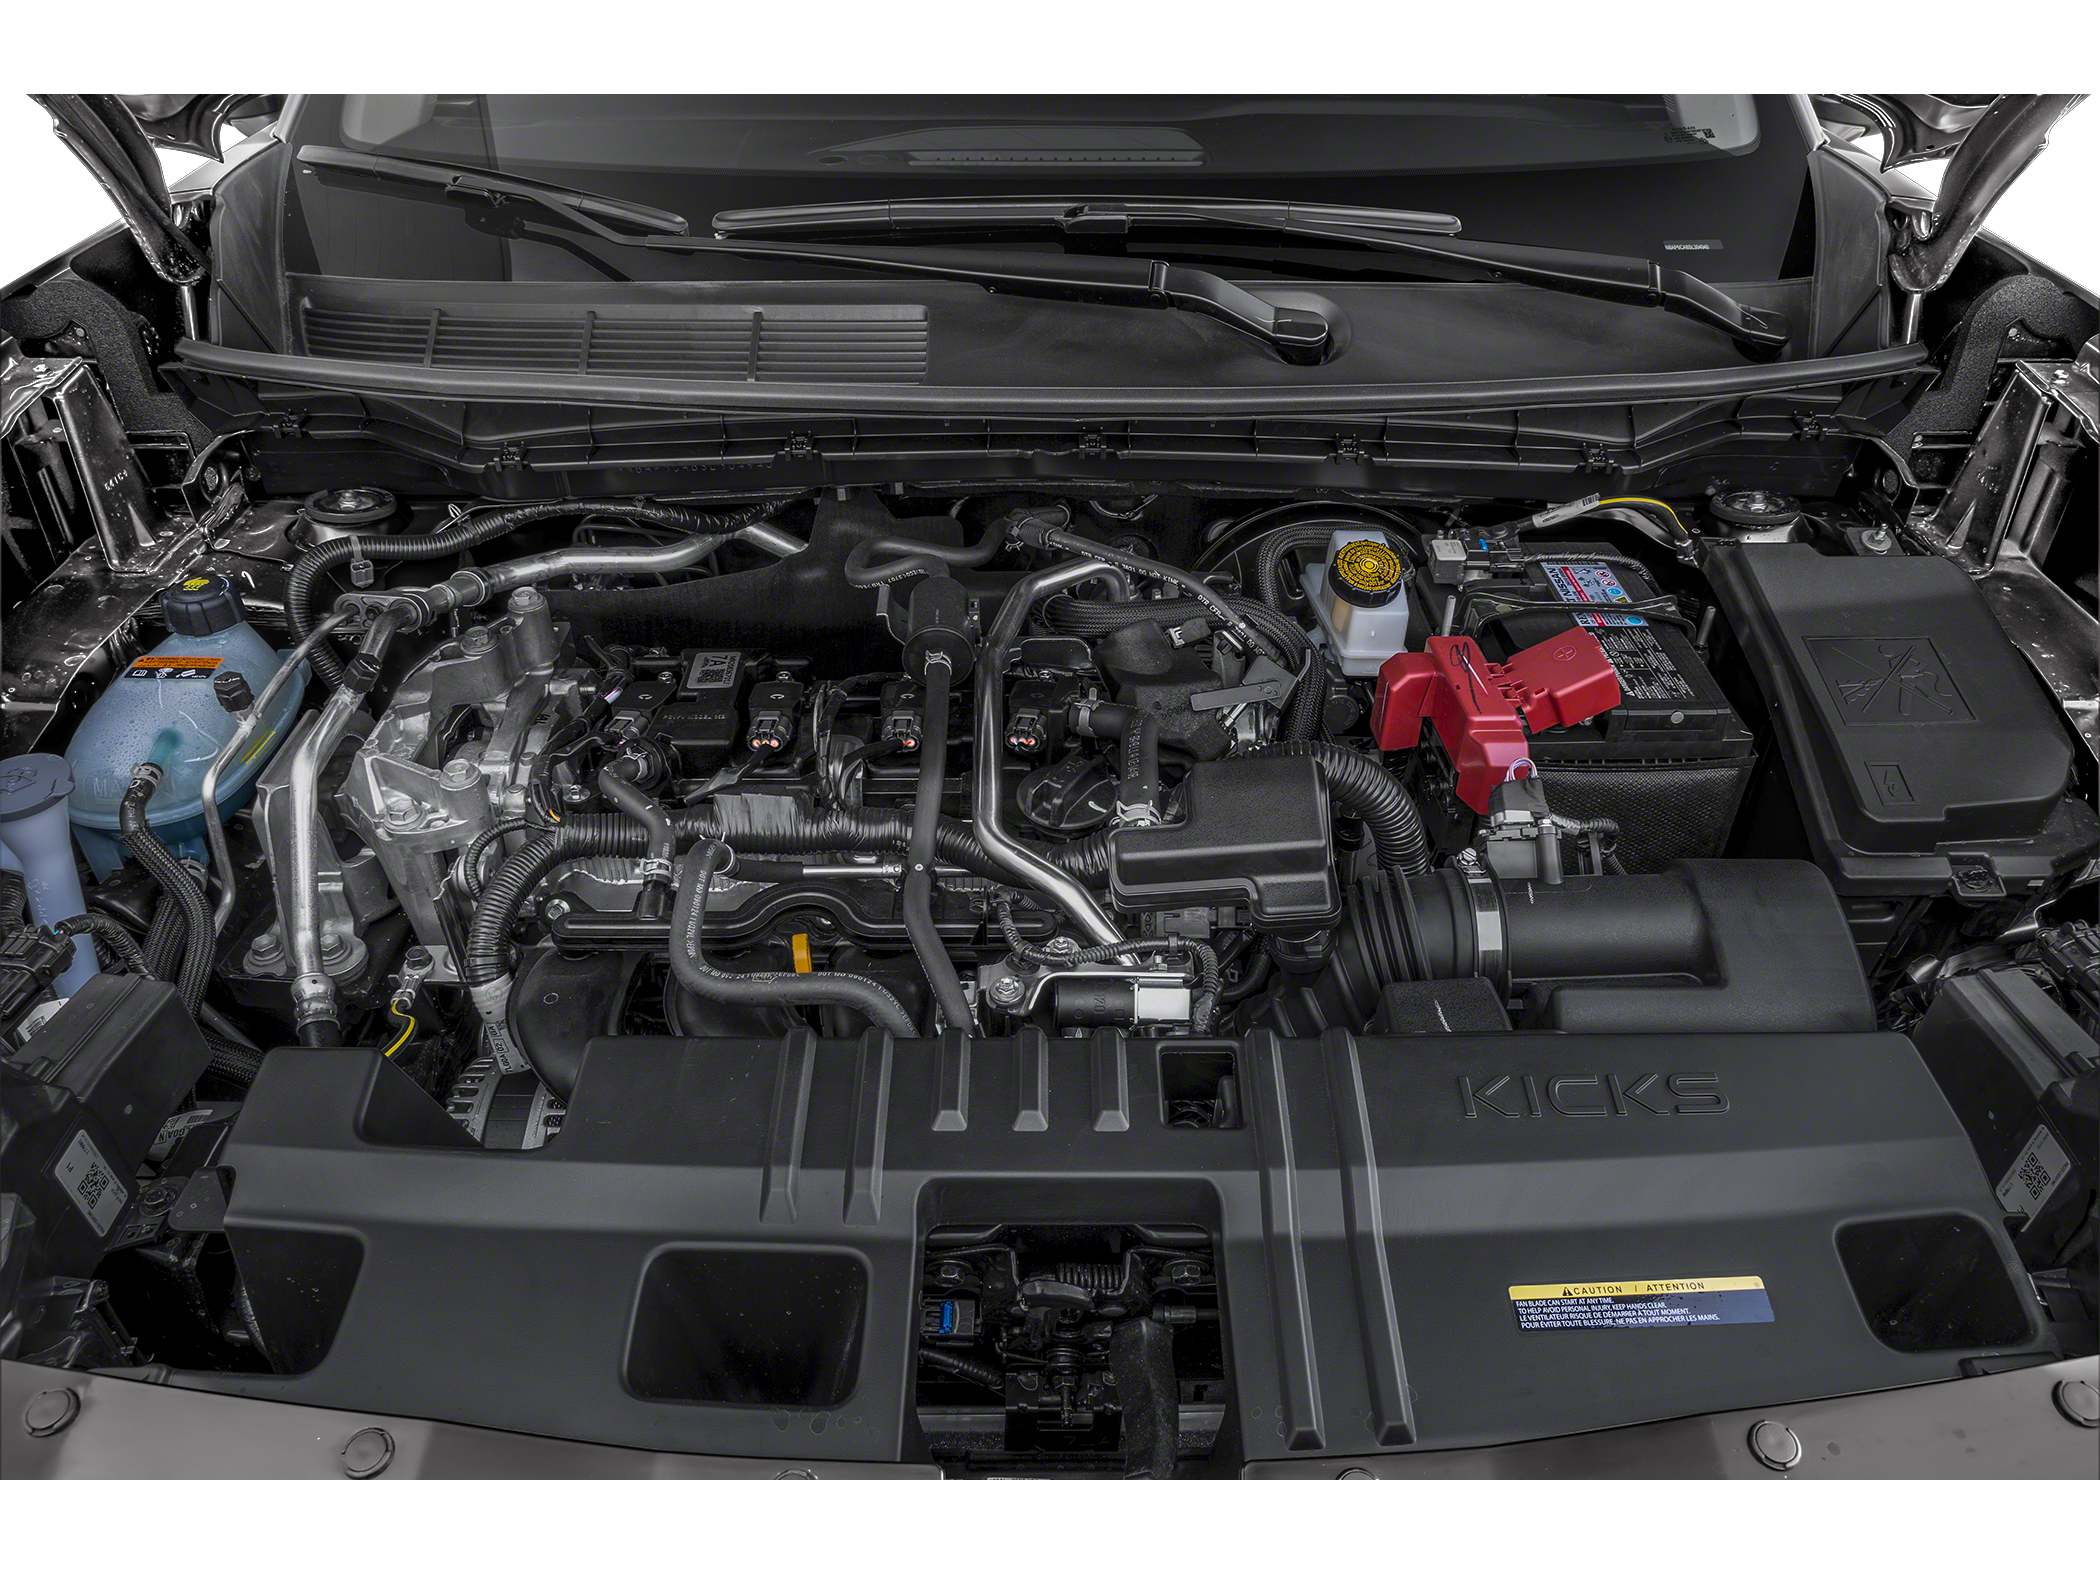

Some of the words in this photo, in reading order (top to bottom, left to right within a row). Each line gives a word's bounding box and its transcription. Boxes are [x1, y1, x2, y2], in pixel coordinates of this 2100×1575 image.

[1547, 567, 1573, 597] NISSAN
[1197, 594, 1209, 606] DTR
[709, 655, 728, 667] 7A
[1457, 1071, 1730, 1119] KICKS
[1573, 1285, 1622, 1295] CAUTION
[1647, 1282, 1705, 1292] ATTENTION
[1518, 1307, 1527, 1315] TO
[1527, 1312, 1569, 1321] VENTILATEUR
[1570, 1312, 1592, 1320] RISQUE
[1521, 1321, 1540, 1329] POUR
[1540, 1320, 1561, 1328] ÉVITER
[1648, 1315, 1686, 1323] APPROCHER
